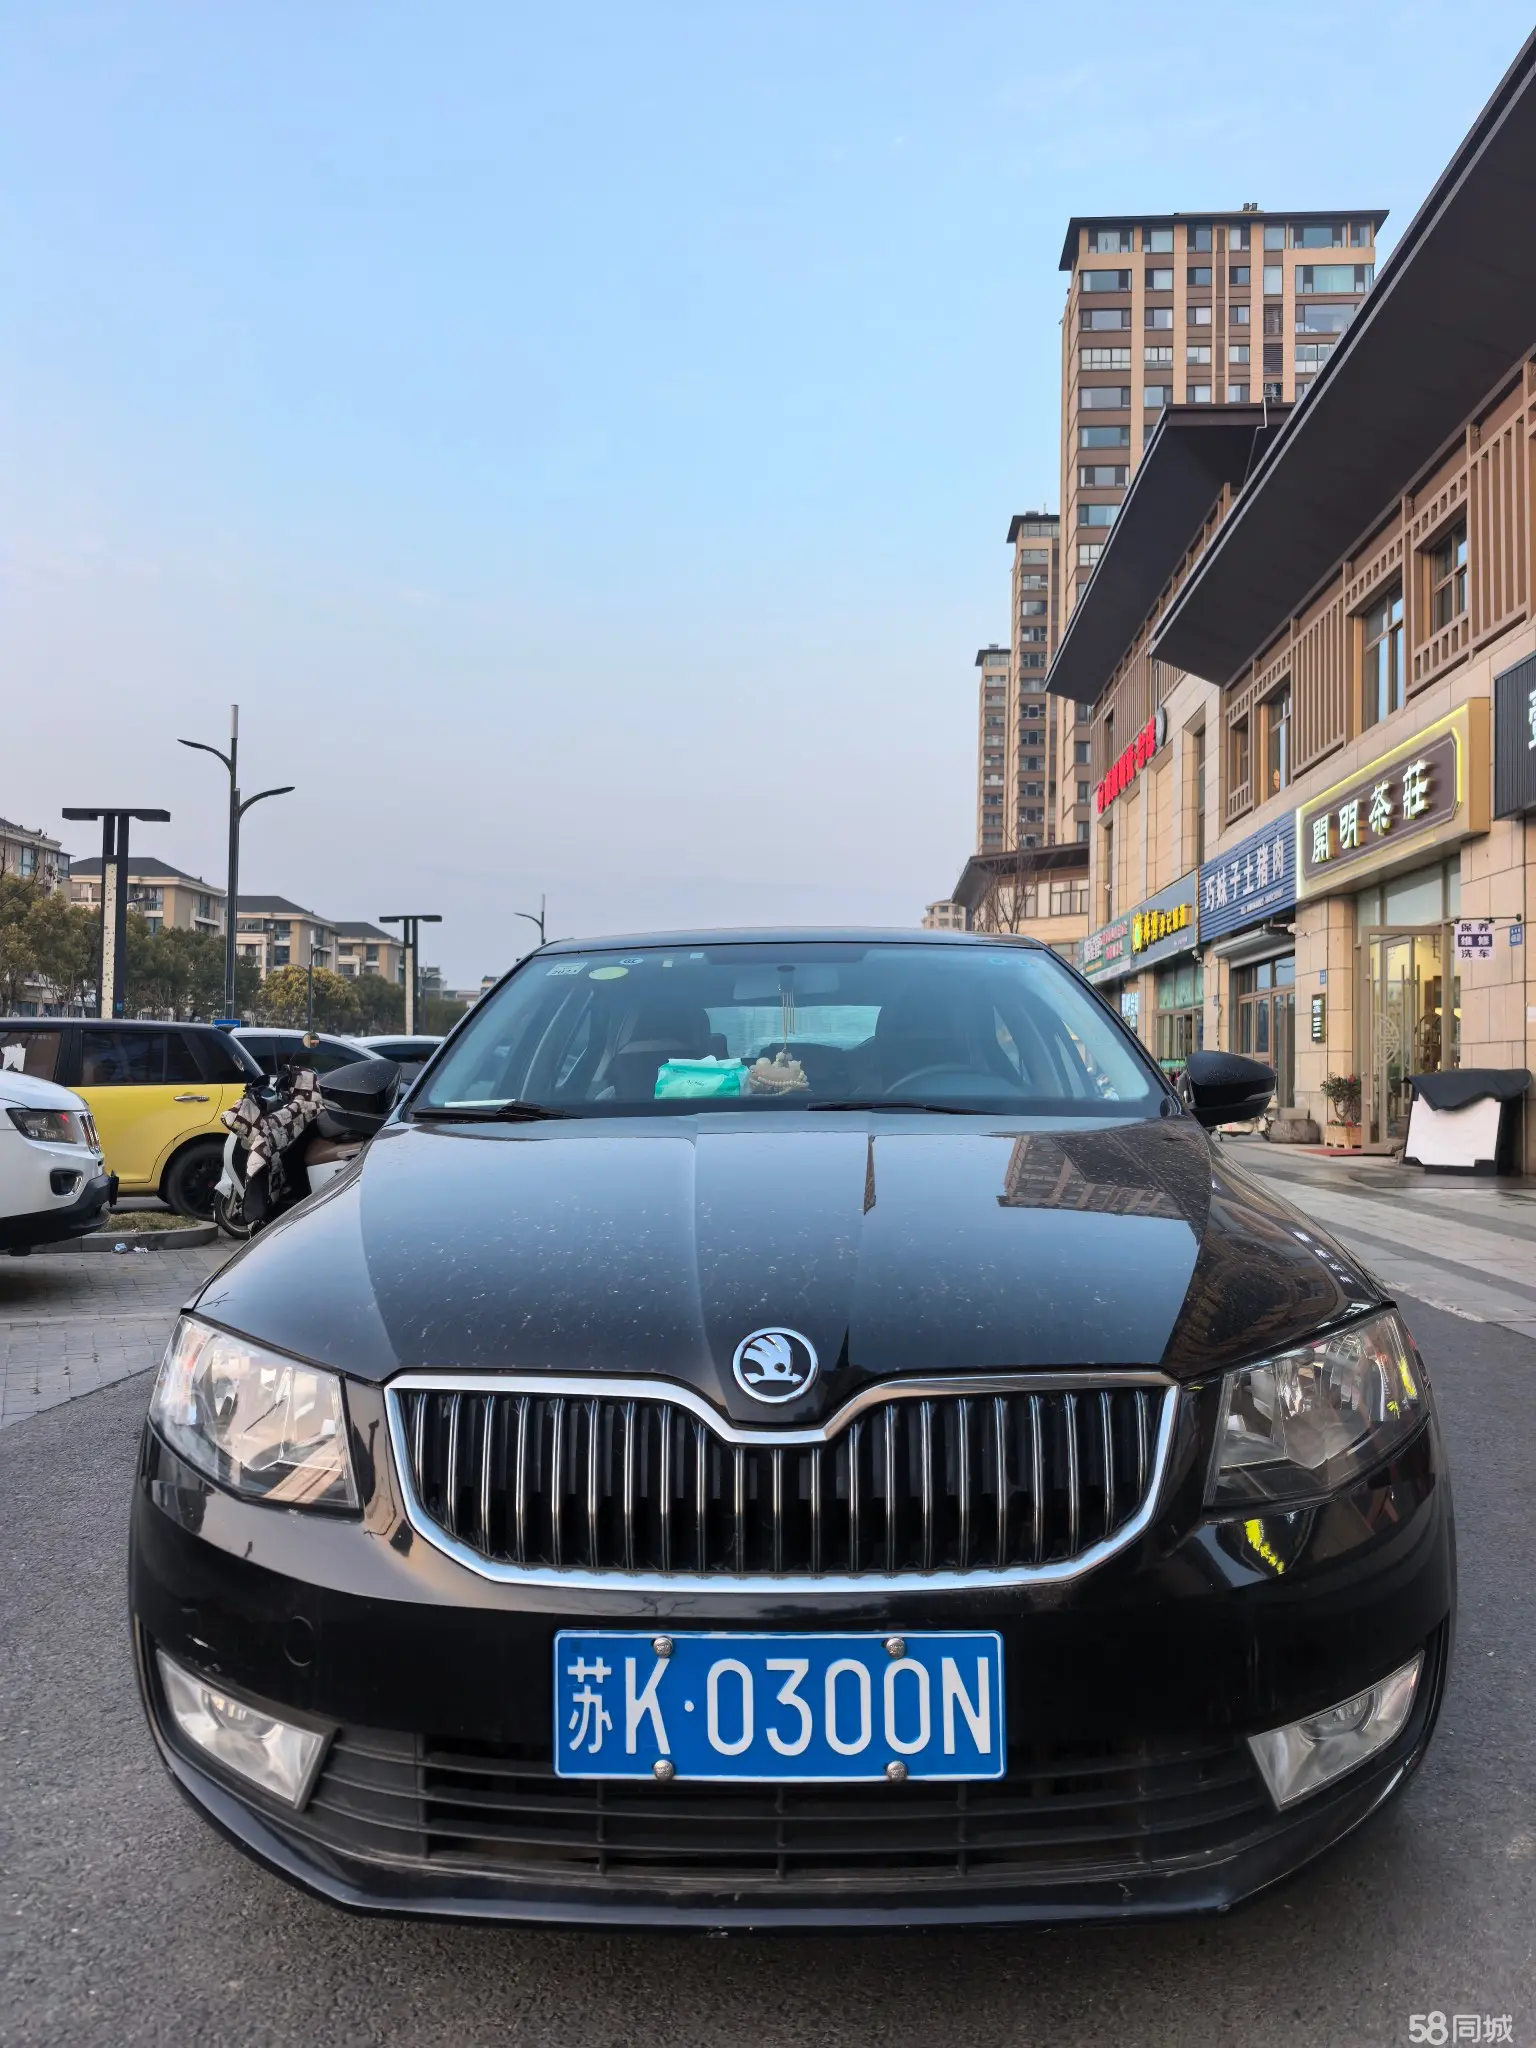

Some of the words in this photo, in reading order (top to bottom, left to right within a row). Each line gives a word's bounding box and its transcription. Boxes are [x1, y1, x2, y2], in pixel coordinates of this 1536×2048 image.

[1461, 923, 1490, 932] 保养
[1460, 935, 1490, 946] 维修
[1461, 949, 1490, 958] 洗车
[567, 1656, 992, 1757] 苏K·0300N
